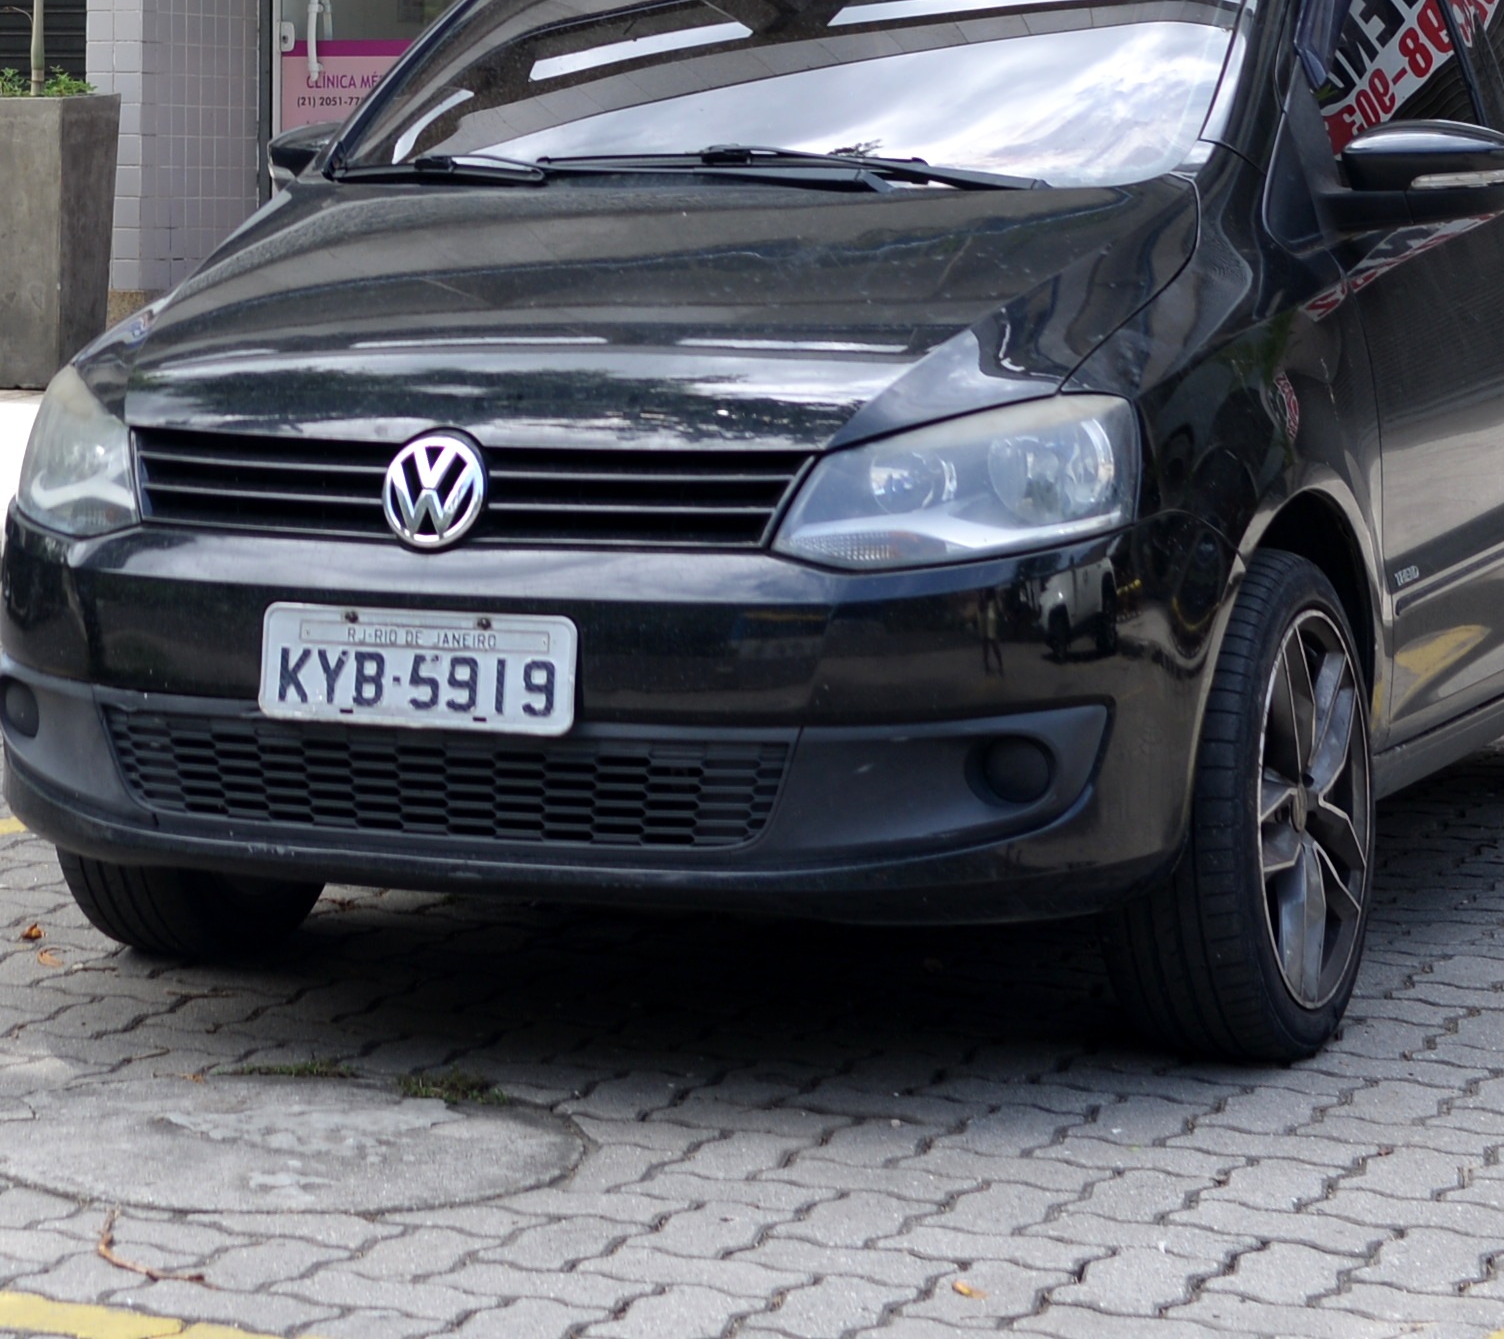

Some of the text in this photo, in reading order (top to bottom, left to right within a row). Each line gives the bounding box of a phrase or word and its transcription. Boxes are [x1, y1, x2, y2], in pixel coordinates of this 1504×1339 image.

[306, 71, 357, 89] CLÍNICA
[297, 96, 316, 108] (21)
[405, 629, 424, 645] DE
[432, 630, 497, 649] JANEIRO
[277, 646, 556, 718] KYB-5919
